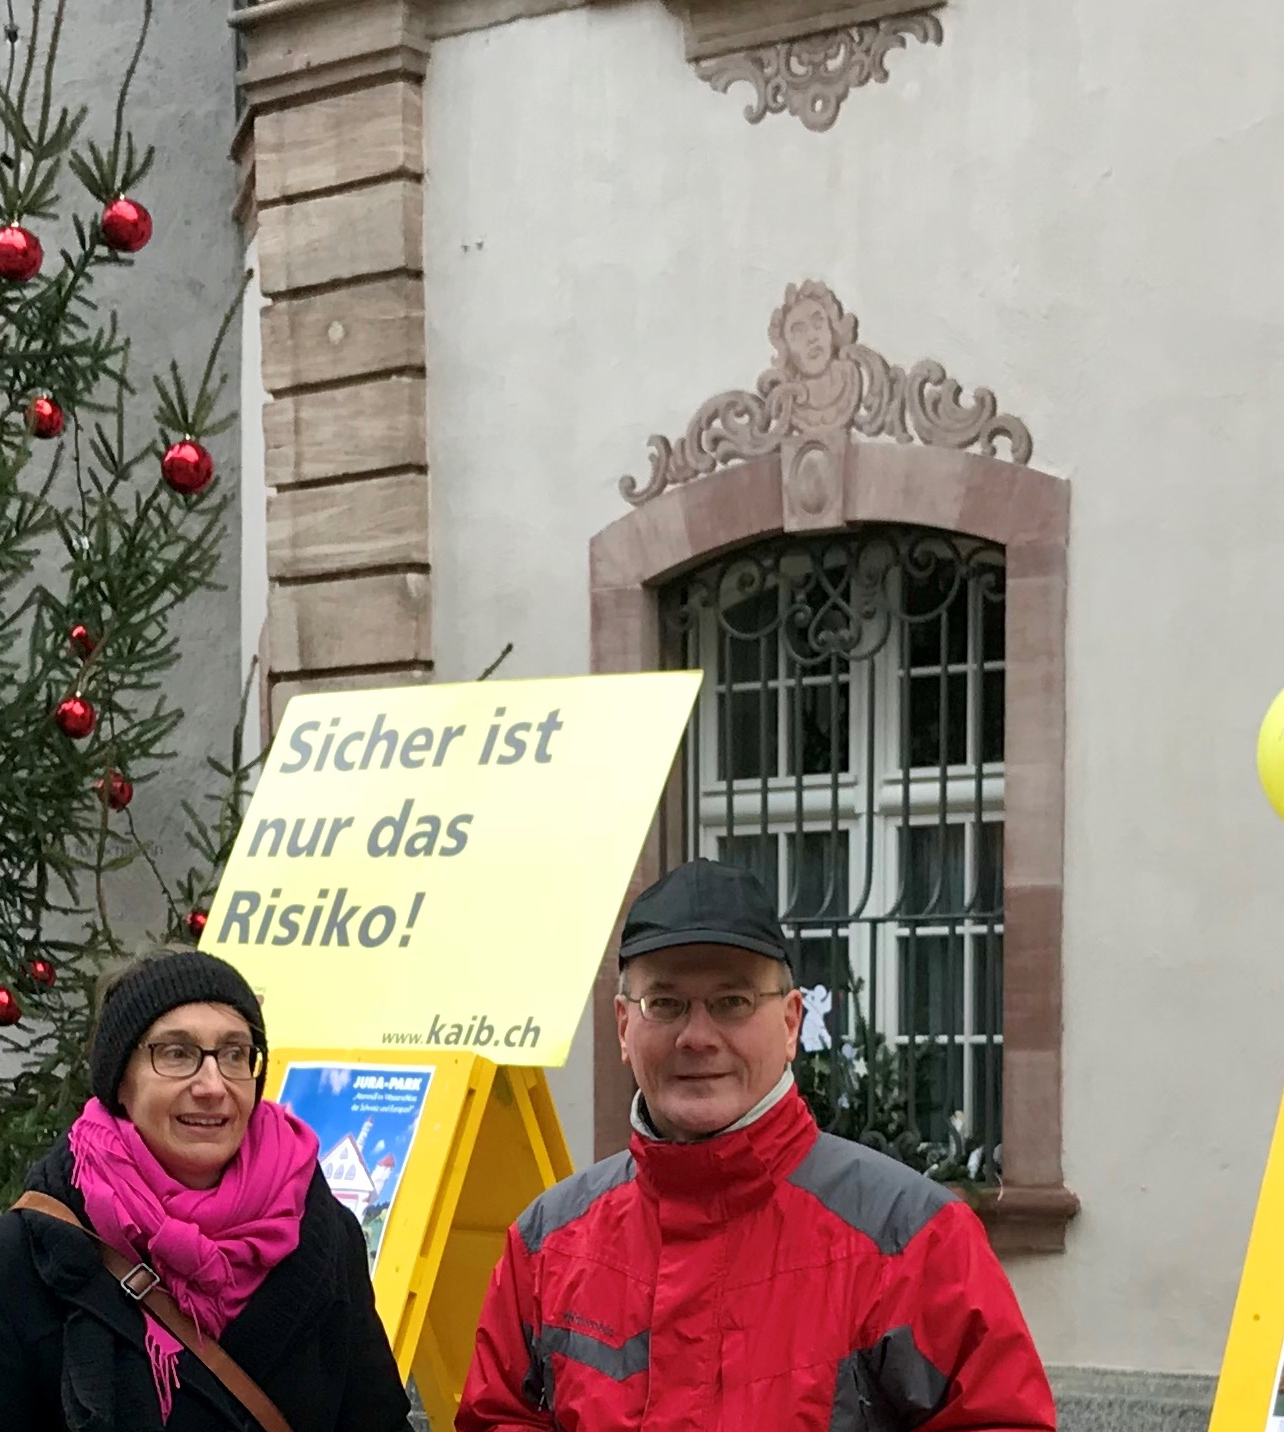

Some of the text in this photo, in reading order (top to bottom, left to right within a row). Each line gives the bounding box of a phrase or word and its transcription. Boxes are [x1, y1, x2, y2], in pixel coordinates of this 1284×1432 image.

[279, 707, 562, 774] Sicher ist
[247, 799, 474, 858] nur das
[216, 889, 426, 948] Risiko!
[382, 1015, 542, 1049] www.kaib.ch
[353, 1076, 422, 1091] JURA-PARK
